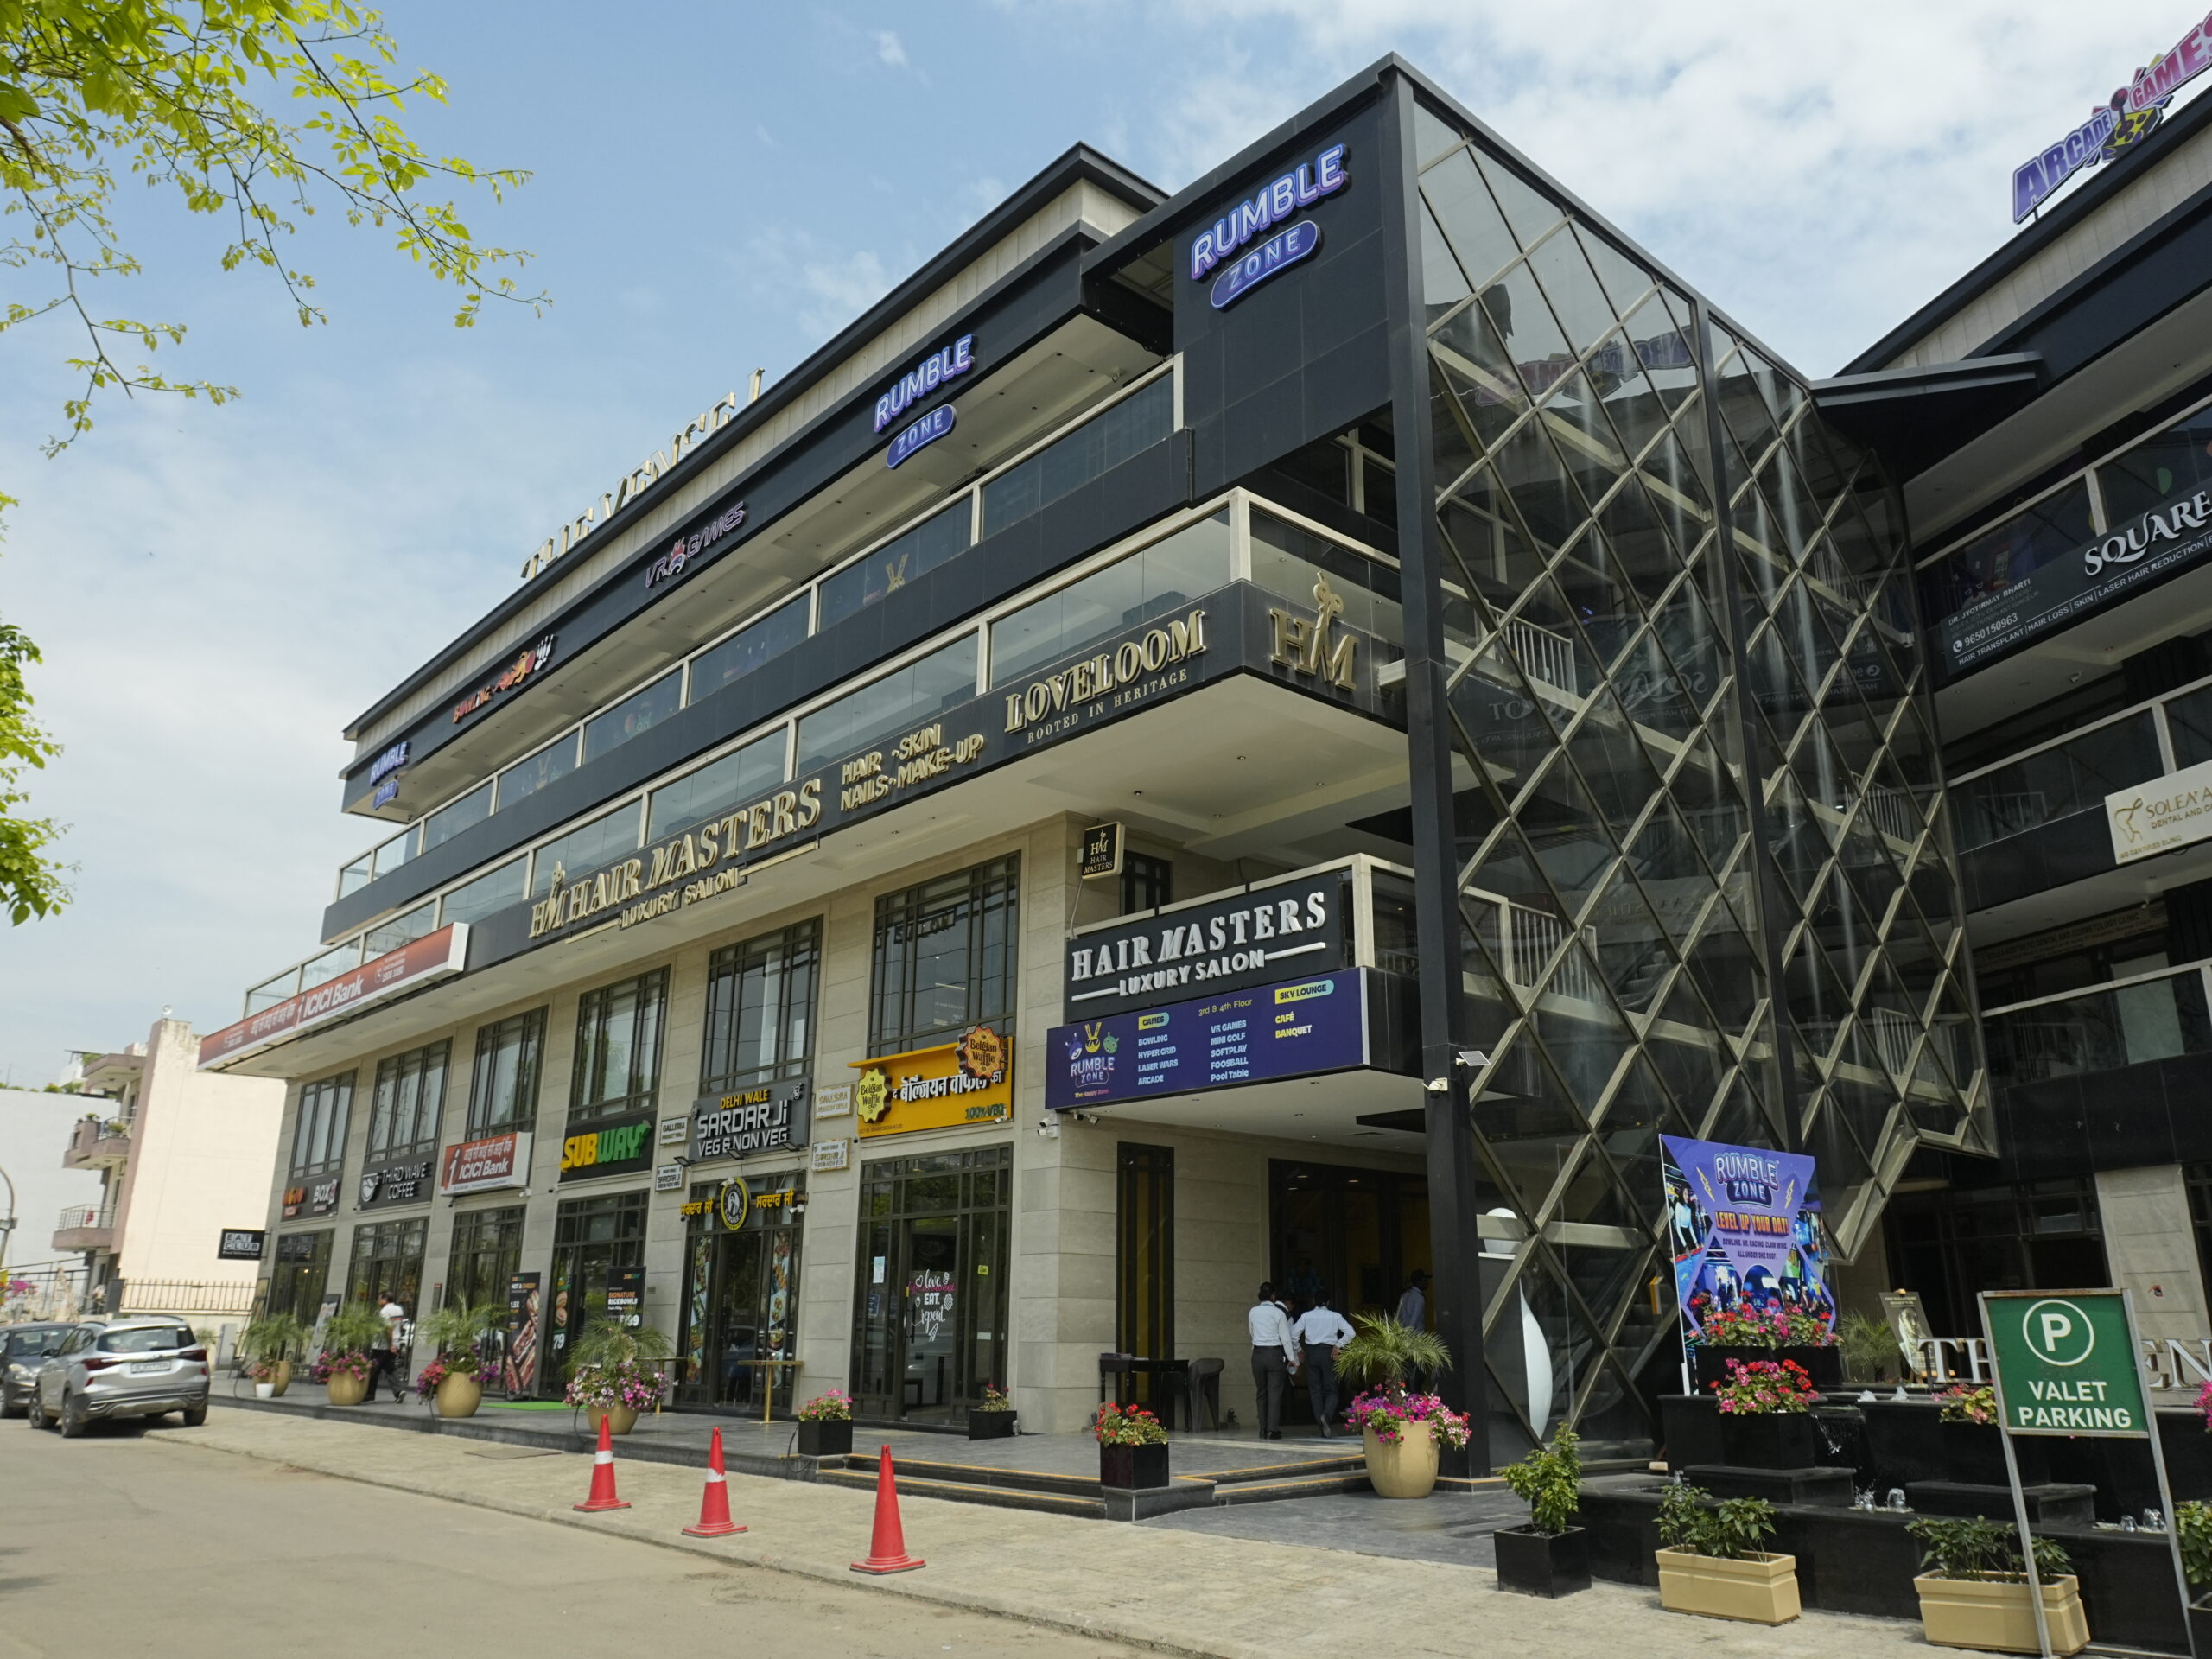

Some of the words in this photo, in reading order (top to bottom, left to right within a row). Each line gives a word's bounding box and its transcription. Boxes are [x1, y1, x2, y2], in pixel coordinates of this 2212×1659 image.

[2012, 109, 2115, 226] ARCADE
[1191, 143, 1351, 280] RUMBLE
[1226, 226, 1302, 295] ZONE
[874, 333, 975, 433] RUMBLE
[896, 409, 945, 457] ZONE
[645, 556, 668, 588] VR
[687, 501, 745, 558] GAMES
[2003, 578, 2031, 598] BHARTI
[1959, 652, 1976, 666] HAIR
[1977, 628, 2024, 656] TRANSPLANT
[2028, 617, 2047, 632] HAIR
[2048, 606, 2069, 621] LOSS
[2075, 594, 2094, 609] SKIN
[2098, 579, 2126, 598] LASER
[2128, 568, 2150, 582] HAIR
[2152, 542, 2204, 571] REDUCTION
[1964, 613, 2018, 646] 9650150963
[1004, 609, 1207, 734] LOVELOOM
[1027, 714, 1079, 744] ROOTED
[1090, 702, 1104, 719] IN
[1114, 669, 1188, 708] HERITAGE
[842, 751, 883, 786] HAIR
[2152, 815, 2183, 830] DENTAL
[2185, 807, 2202, 819] AND
[567, 859, 641, 922] HAIR
[645, 778, 821, 891] MASTERS
[1090, 855, 1107, 864] HAIR
[1084, 861, 1113, 874] MASTERS
[621, 888, 677, 929] LUXURY
[684, 866, 741, 906] SALON
[1071, 936, 1153, 982] HAIR
[1157, 892, 1325, 963] MASTERS
[1119, 964, 1191, 996] LUXURY
[1195, 949, 1265, 982] SALON
[303, 986, 334, 1018] ICICI
[332, 974, 364, 1007] Bank
[1280, 989, 1295, 1001] SKY
[1296, 983, 1327, 996] LOUNGE
[1198, 1006, 1210, 1017] 3rd
[1219, 1001, 1232, 1013] 4th
[1234, 998, 1253, 1009] Floor
[1275, 1010, 1294, 1024] CAFÉ
[1142, 1015, 1165, 1027] GAMES
[1211, 1024, 1221, 1033] VR
[1222, 1020, 1247, 1031] GAMES
[1275, 1024, 1313, 1039] BANQUET
[970, 1039, 997, 1058] Belgian
[1138, 1034, 1168, 1046] BOWLING
[1211, 1035, 1226, 1046] MINI
[1227, 1033, 1246, 1043] GOLF
[972, 1051, 995, 1066] Waffle
[1138, 1048, 1160, 1059] HYPER
[1160, 1046, 1177, 1055] GRID
[1211, 1044, 1247, 1058] SOFTPLAY
[1071, 1056, 1116, 1077] RUMBLE
[1138, 1061, 1159, 1072] LASER
[1160, 1058, 1179, 1070] WARS
[1211, 1056, 1249, 1070] FOOSBALL
[1081, 1071, 1104, 1084] ZONE
[1138, 1074, 1164, 1086] ARCADE
[1211, 1073, 1228, 1082] Pool
[1229, 1069, 1249, 1079] Table
[720, 1093, 742, 1109] DELHI
[744, 1089, 768, 1105] WALE
[861, 1082, 883, 1096] Belgian
[1084, 1090, 1097, 1098] Happy
[862, 1092, 881, 1109] Waffle
[696, 1103, 770, 1139] SARDAR
[560, 1121, 652, 1173] SUBWAY
[697, 1137, 721, 1157] VEG
[732, 1130, 761, 1151] NON
[762, 1127, 788, 1146] VEG
[381, 1166, 404, 1184] THIRD
[404, 1162, 427, 1181] WAVE
[458, 1160, 484, 1180] ICICI
[482, 1157, 509, 1176] Bank
[1715, 1153, 1778, 1190] RUMBLE
[387, 1181, 415, 1200] COFFEE
[1733, 1180, 1766, 1201] ZONE
[1715, 1211, 1739, 1233] LEVEL
[1739, 1213, 1751, 1234] UP
[1751, 1214, 1771, 1236] YOUR
[1771, 1217, 1789, 1237] DAY!
[224, 1243, 260, 1251] CLUB
[226, 1233, 252, 1242] EAT
[924, 1293, 940, 1306] EAT.
[2040, 1313, 2072, 1352] P
[2028, 1380, 2107, 1402] VALET
[2018, 1406, 2132, 1428] PARKING
